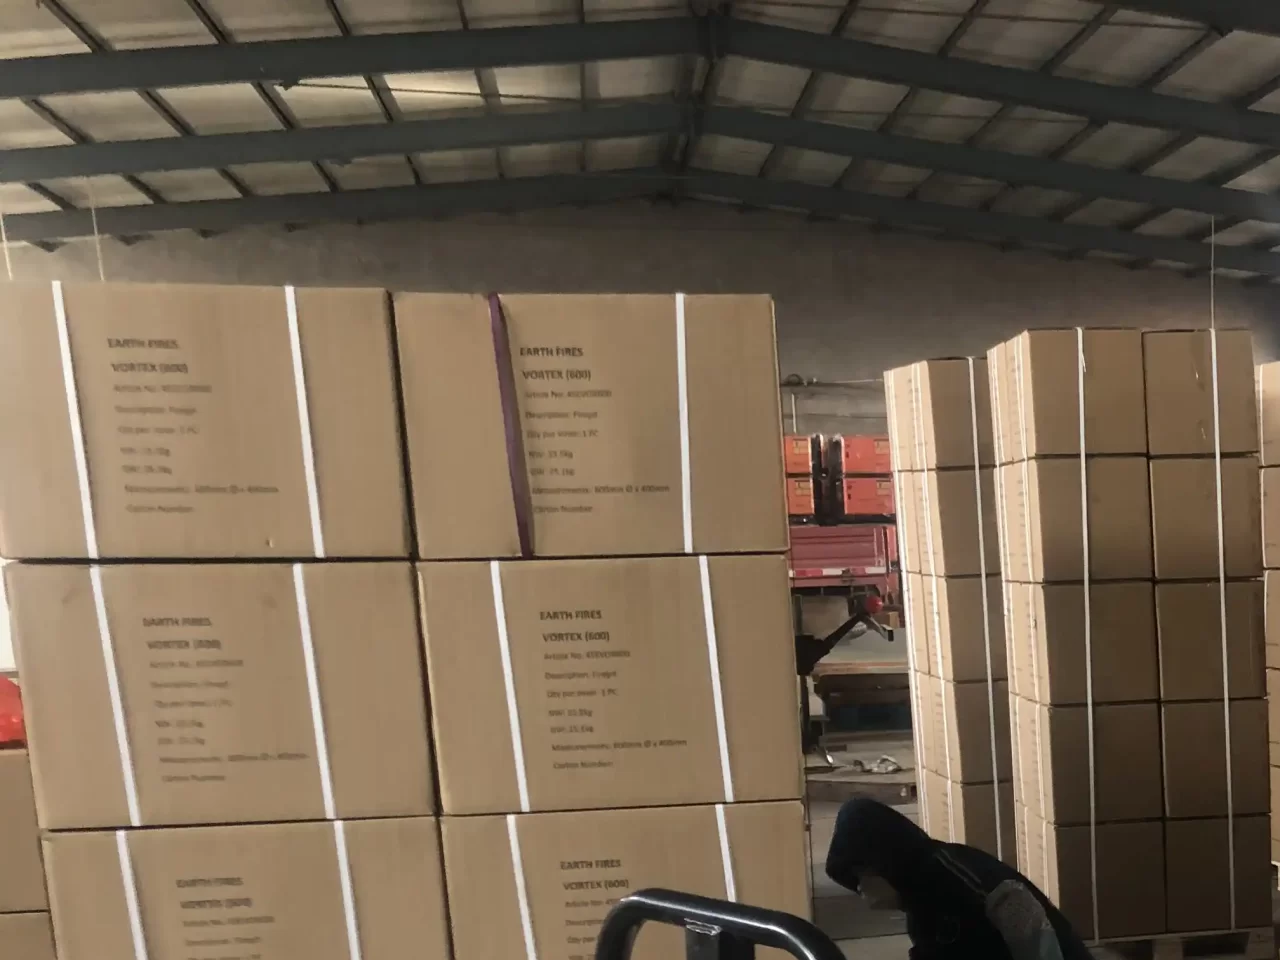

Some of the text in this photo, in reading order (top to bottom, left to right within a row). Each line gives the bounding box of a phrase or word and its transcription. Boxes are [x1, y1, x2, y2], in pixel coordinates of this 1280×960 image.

[520, 347, 583, 357] EARTH FIRES
[522, 369, 591, 381] VORTEX (600)
[540, 610, 602, 620] EARTH FIRES
[542, 631, 610, 642] VORTEX (600)
[560, 859, 621, 870] EARTH FIRES
[563, 881, 604, 891] VORTEX
